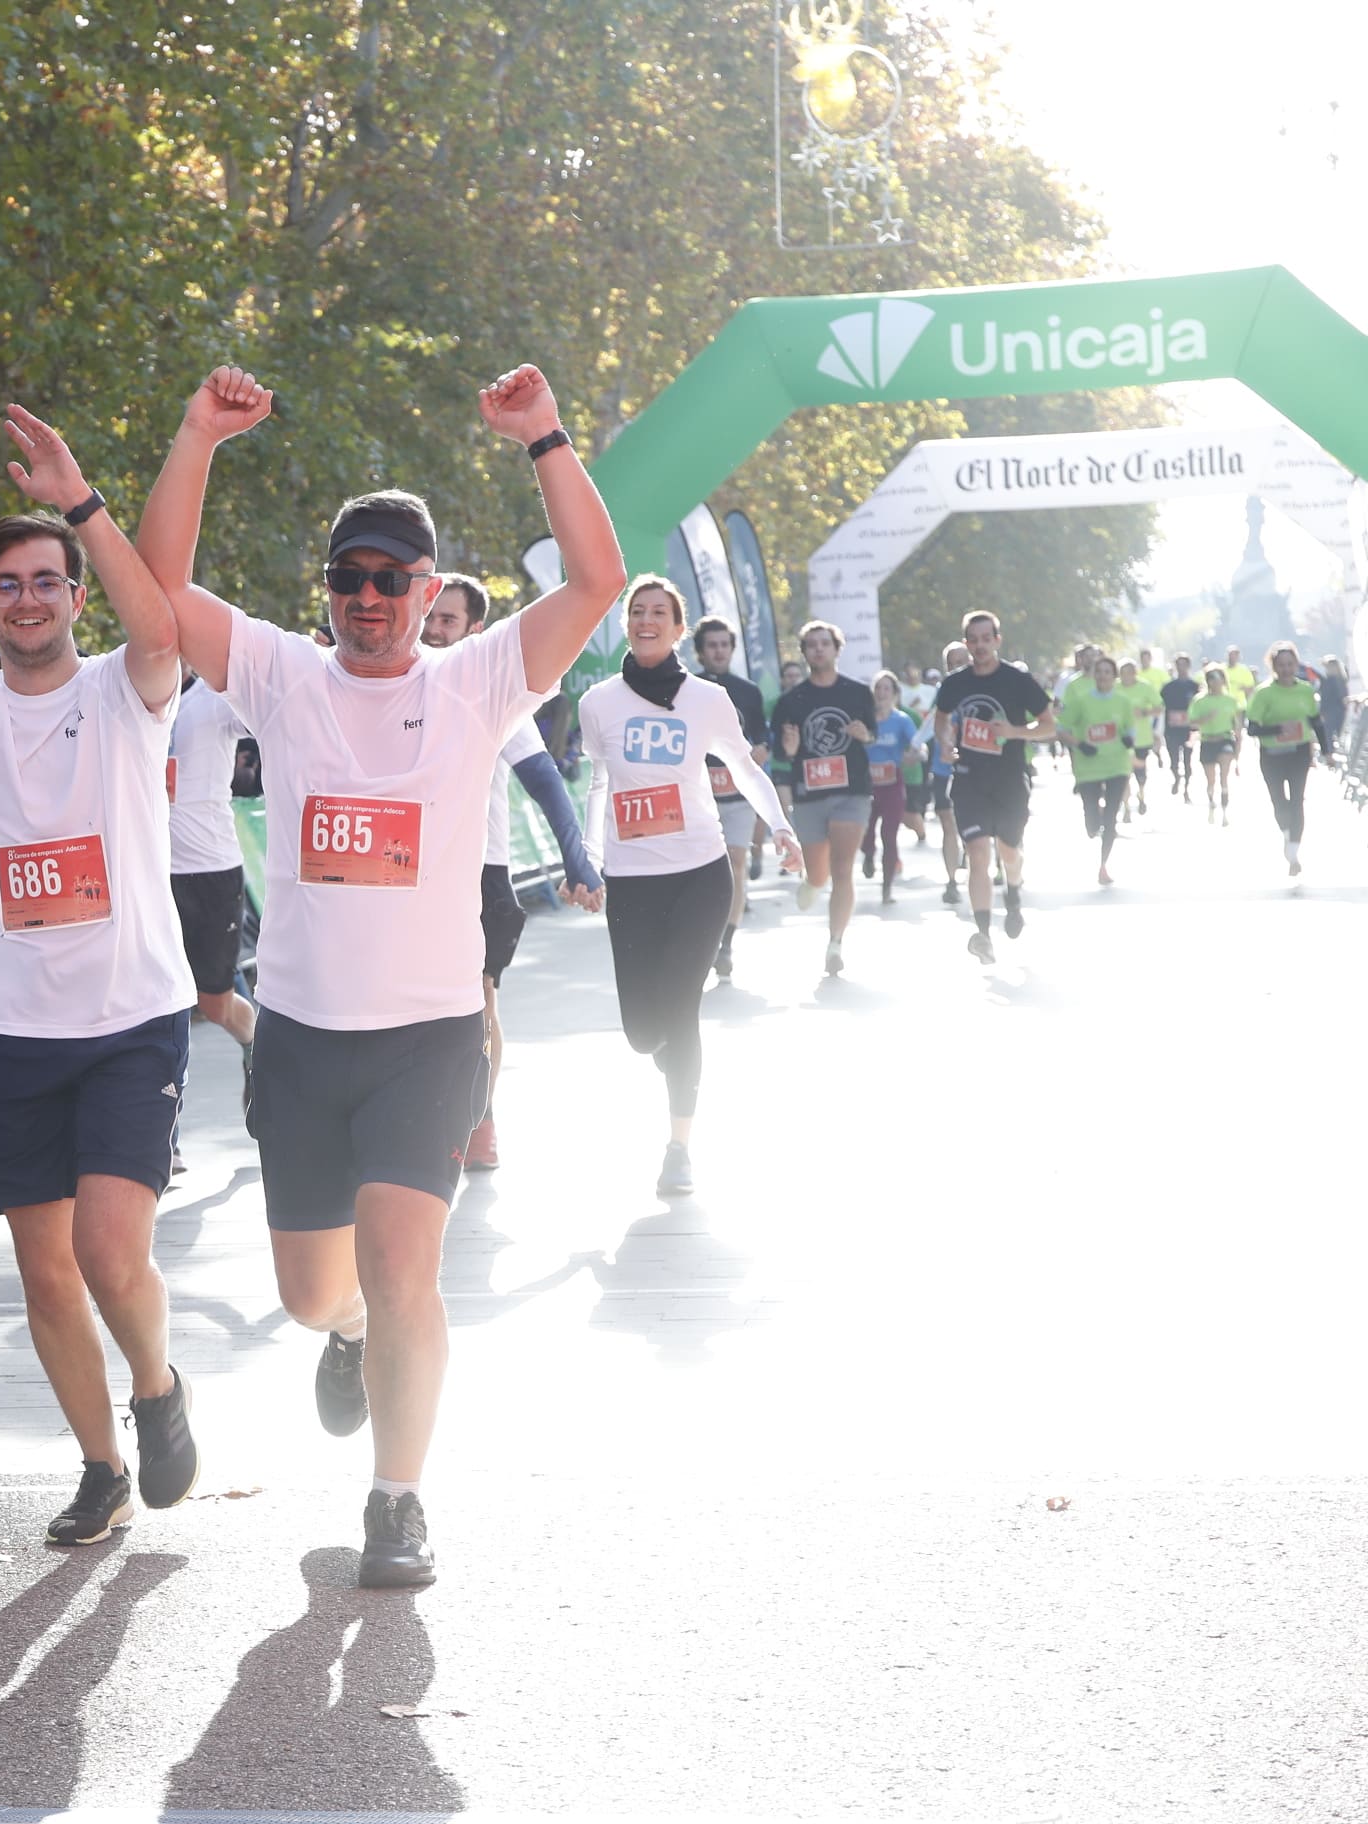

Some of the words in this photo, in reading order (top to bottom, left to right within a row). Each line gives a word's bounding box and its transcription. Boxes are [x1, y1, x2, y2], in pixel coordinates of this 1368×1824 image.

[950, 306, 1208, 377] Unicaja
[955, 458, 993, 492] El
[1000, 456, 1081, 490] Norte
[1086, 456, 1117, 485] de
[1123, 445, 1246, 483] Castilla
[626, 720, 685, 760] PPG
[621, 796, 654, 822] 771
[312, 813, 373, 854] 685
[8, 858, 62, 900] 686
